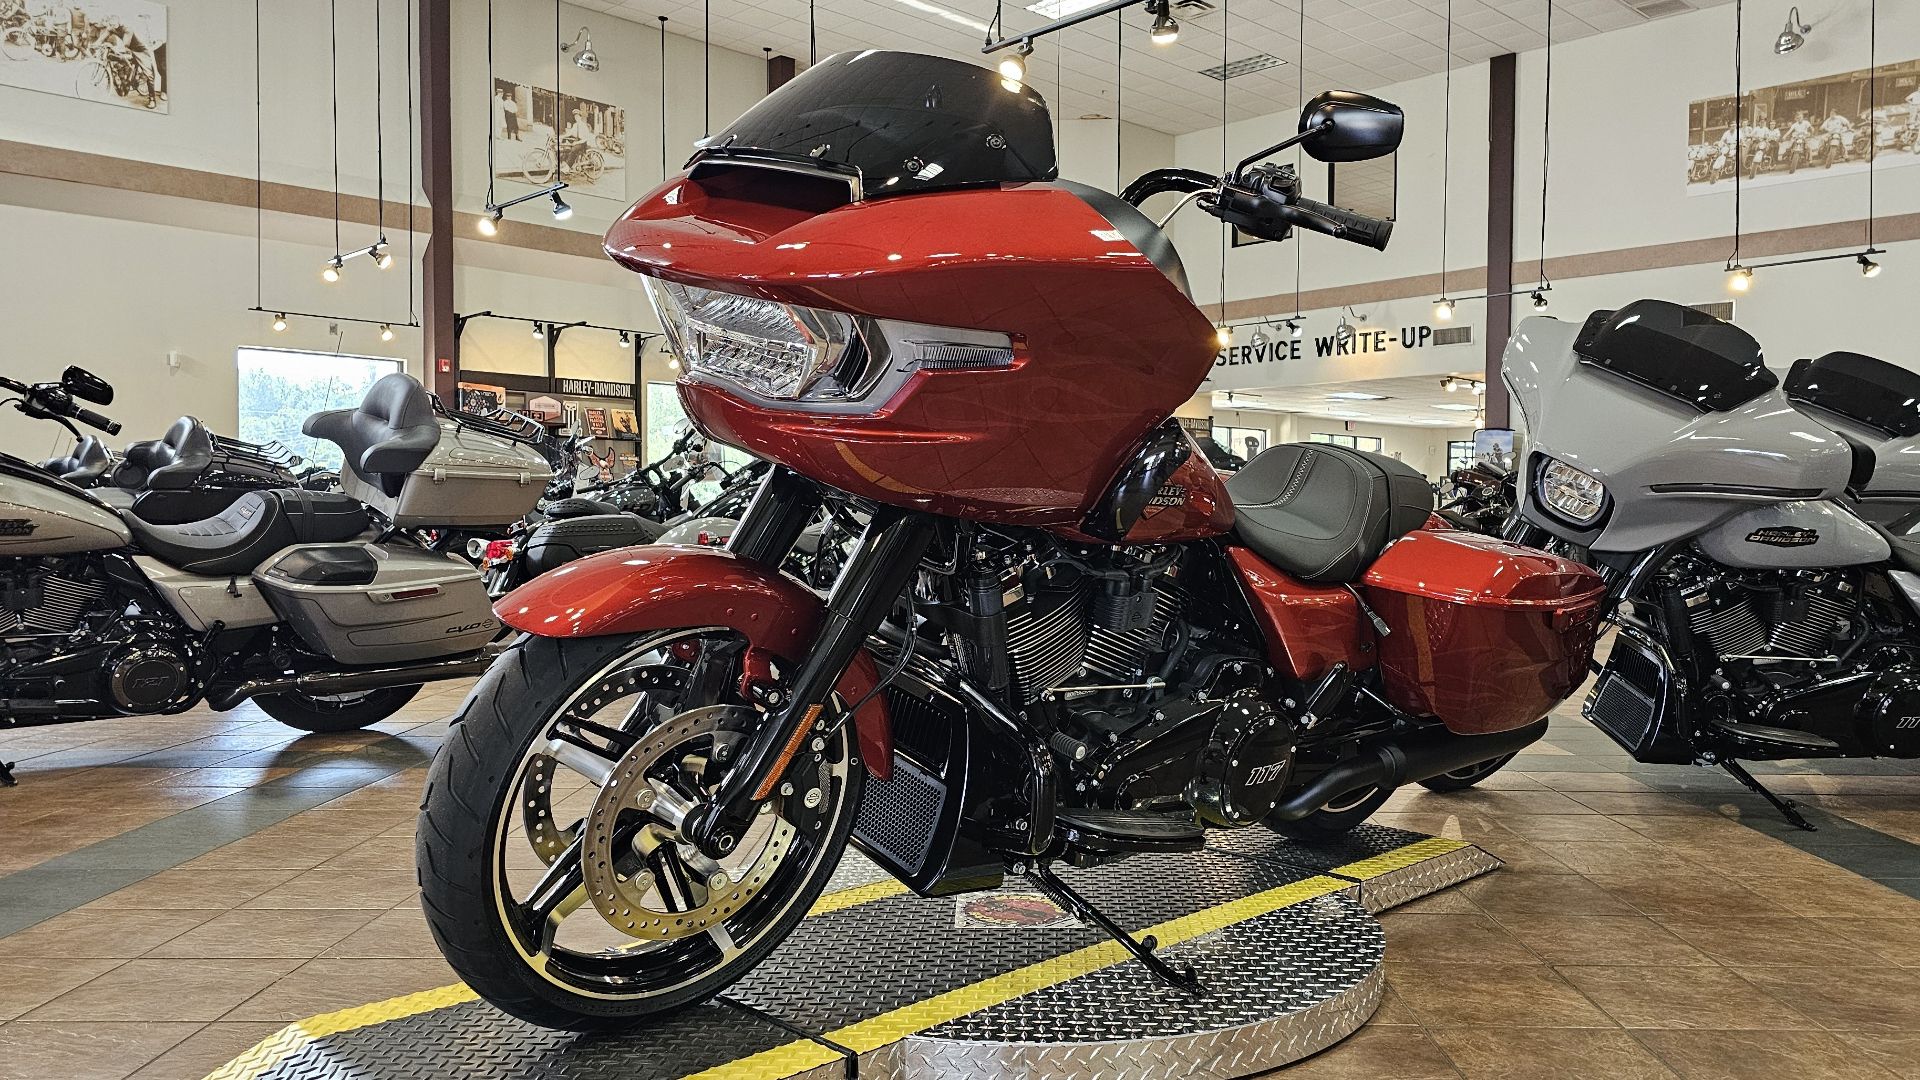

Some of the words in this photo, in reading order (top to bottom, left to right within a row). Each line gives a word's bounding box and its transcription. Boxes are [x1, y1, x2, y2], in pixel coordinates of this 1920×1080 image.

[1215, 339, 1302, 367] SERVICE
[1314, 325, 1432, 358] WRITE-UP
[562, 379, 631, 398] HARLEY-DAVIDSON
[1148, 497, 1186, 506] IDSON
[445, 622, 482, 634] CVO
[1895, 716, 1920, 729] 11
[1244, 759, 1287, 787] 117
